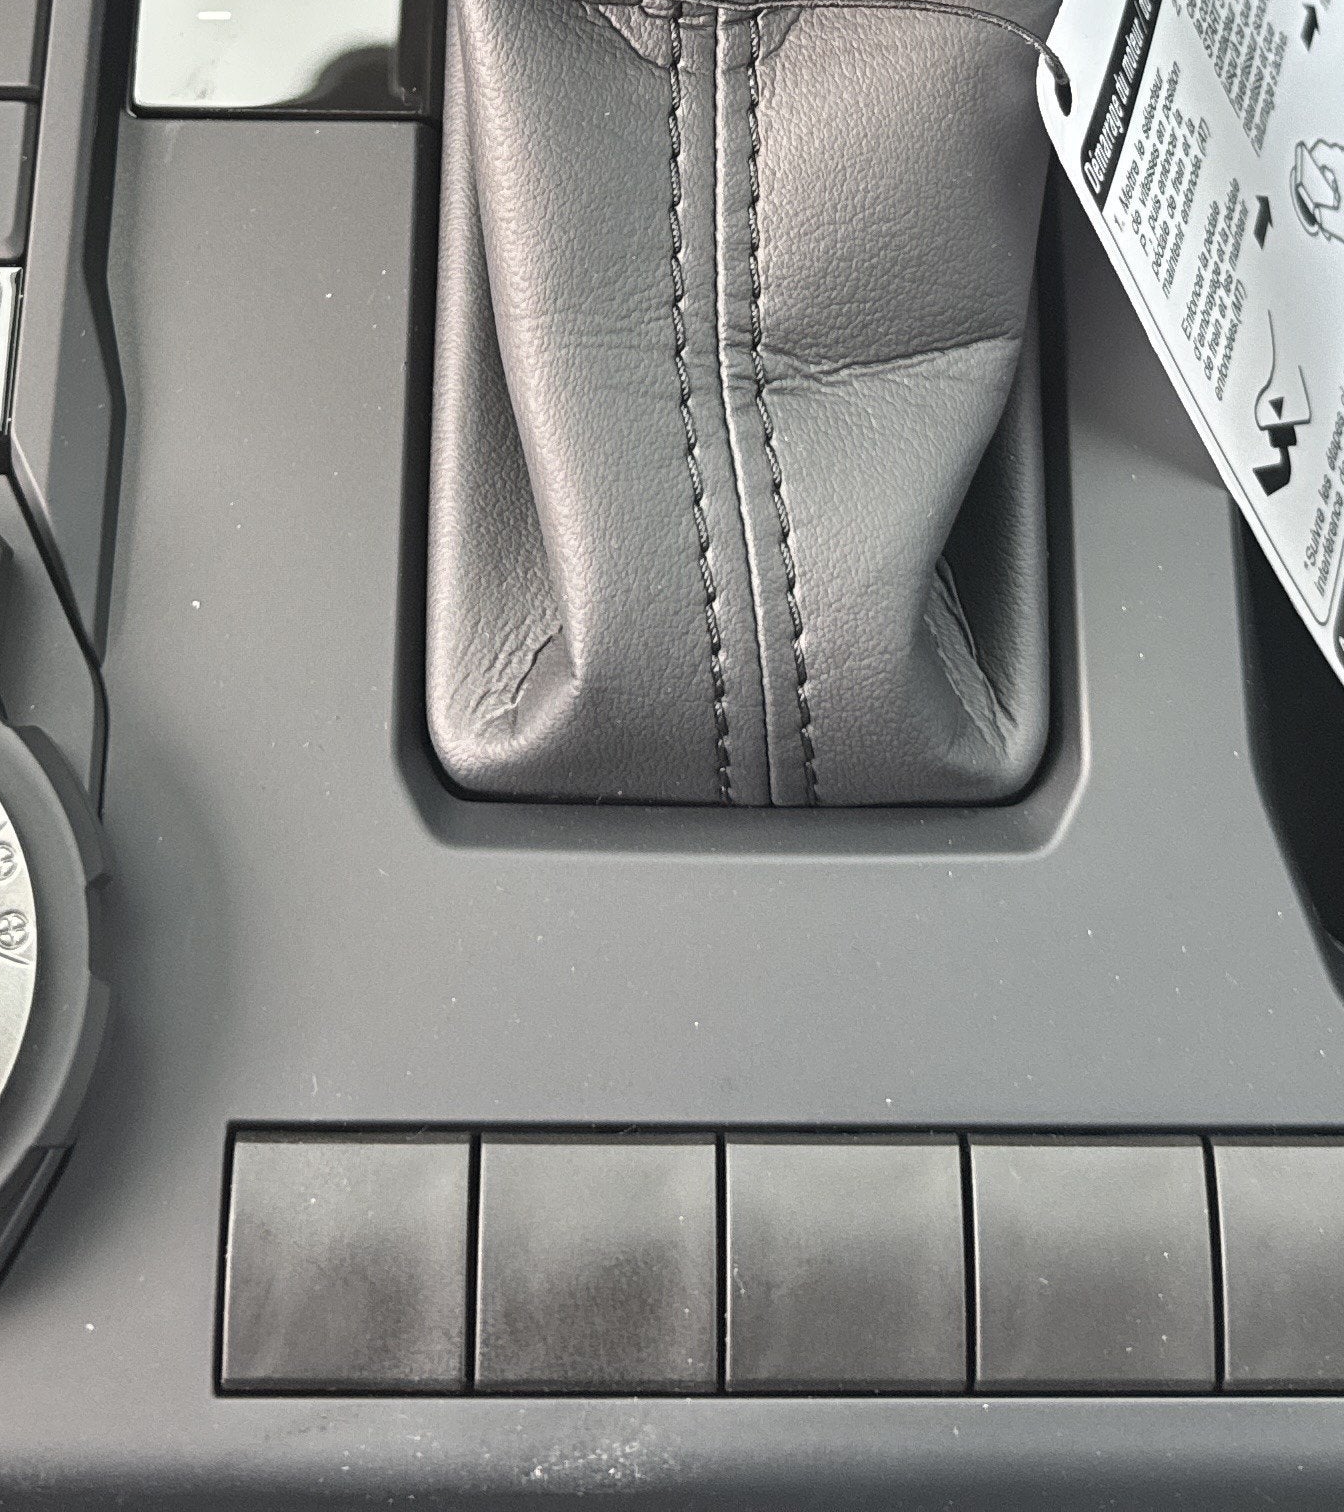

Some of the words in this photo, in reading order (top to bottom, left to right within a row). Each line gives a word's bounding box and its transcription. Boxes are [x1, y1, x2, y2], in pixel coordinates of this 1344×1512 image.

[1121, 17, 1143, 82] moteur
[1192, 17, 1204, 39] le
[1202, 0, 1221, 59] START
[1234, 22, 1245, 47] ce
[1113, 71, 1130, 104] du
[1084, 95, 1123, 193] Démarrage
[1118, 159, 1139, 213] Mettre
[1133, 138, 1145, 160] le
[1141, 67, 1163, 139] sélecteur
[1130, 208, 1142, 235] de
[1138, 142, 1160, 207] vitesses
[1155, 119, 1166, 145] en
[1161, 60, 1181, 124] position
[1181, 133, 1191, 158] et
[1184, 116, 1196, 138] la
[1147, 193, 1161, 238] puis
[1157, 121, 1178, 195] enfoncer
[1171, 107, 1183, 129] la
[1170, 157, 1185, 195] frein
[1161, 221, 1184, 298] maintenir
[1180, 154, 1202, 225] enfoncée.
[1196, 116, 1211, 157] (AT)
[1165, 193, 1177, 219] de
[1223, 177, 1243, 237] pédale
[1228, 198, 1249, 271] maintenir
[1151, 219, 1170, 281] pédale
[1215, 239, 1226, 264] et
[1217, 226, 1229, 247] la
[1180, 266, 1204, 340] Enfoncer
[1197, 250, 1209, 271] la
[1203, 199, 1220, 258] pédale
[1218, 268, 1233, 297] les
[1193, 257, 1221, 361] d'embrayage
[1213, 294, 1228, 319] et
[1207, 317, 1222, 358] frein
[1202, 354, 1214, 381] de
[1317, 473, 1332, 505] les
[1325, 411, 1344, 471] étapes
[1315, 490, 1344, 596] interférence
